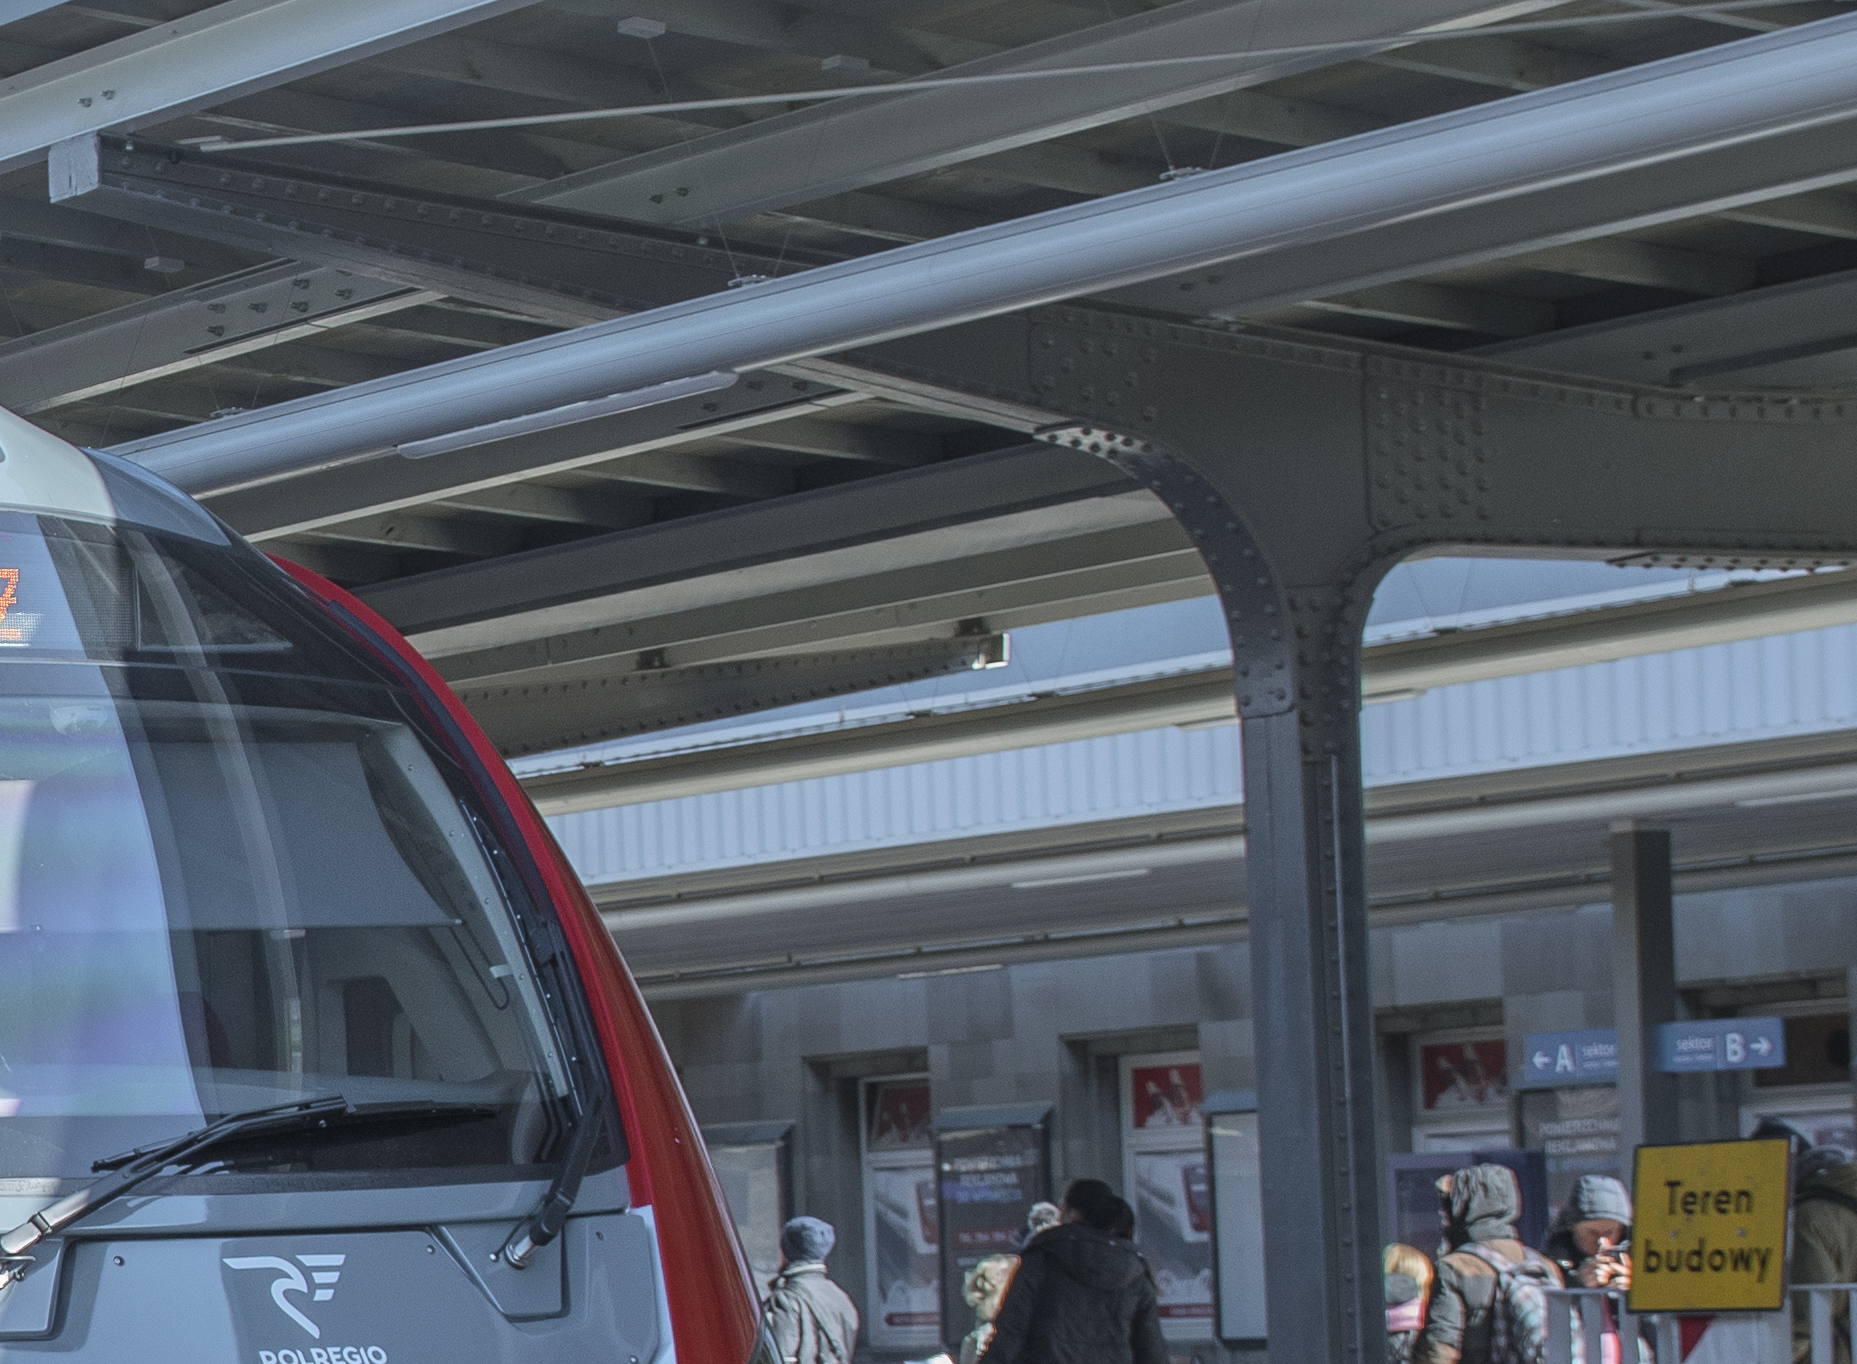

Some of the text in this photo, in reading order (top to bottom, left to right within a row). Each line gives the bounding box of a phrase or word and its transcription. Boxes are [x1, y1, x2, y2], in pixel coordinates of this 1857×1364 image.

[1555, 1043, 1576, 1075] A
[1725, 1032, 1746, 1064] B
[1664, 1180, 1754, 1217] Teren
[1643, 1237, 1773, 1284] budowy
